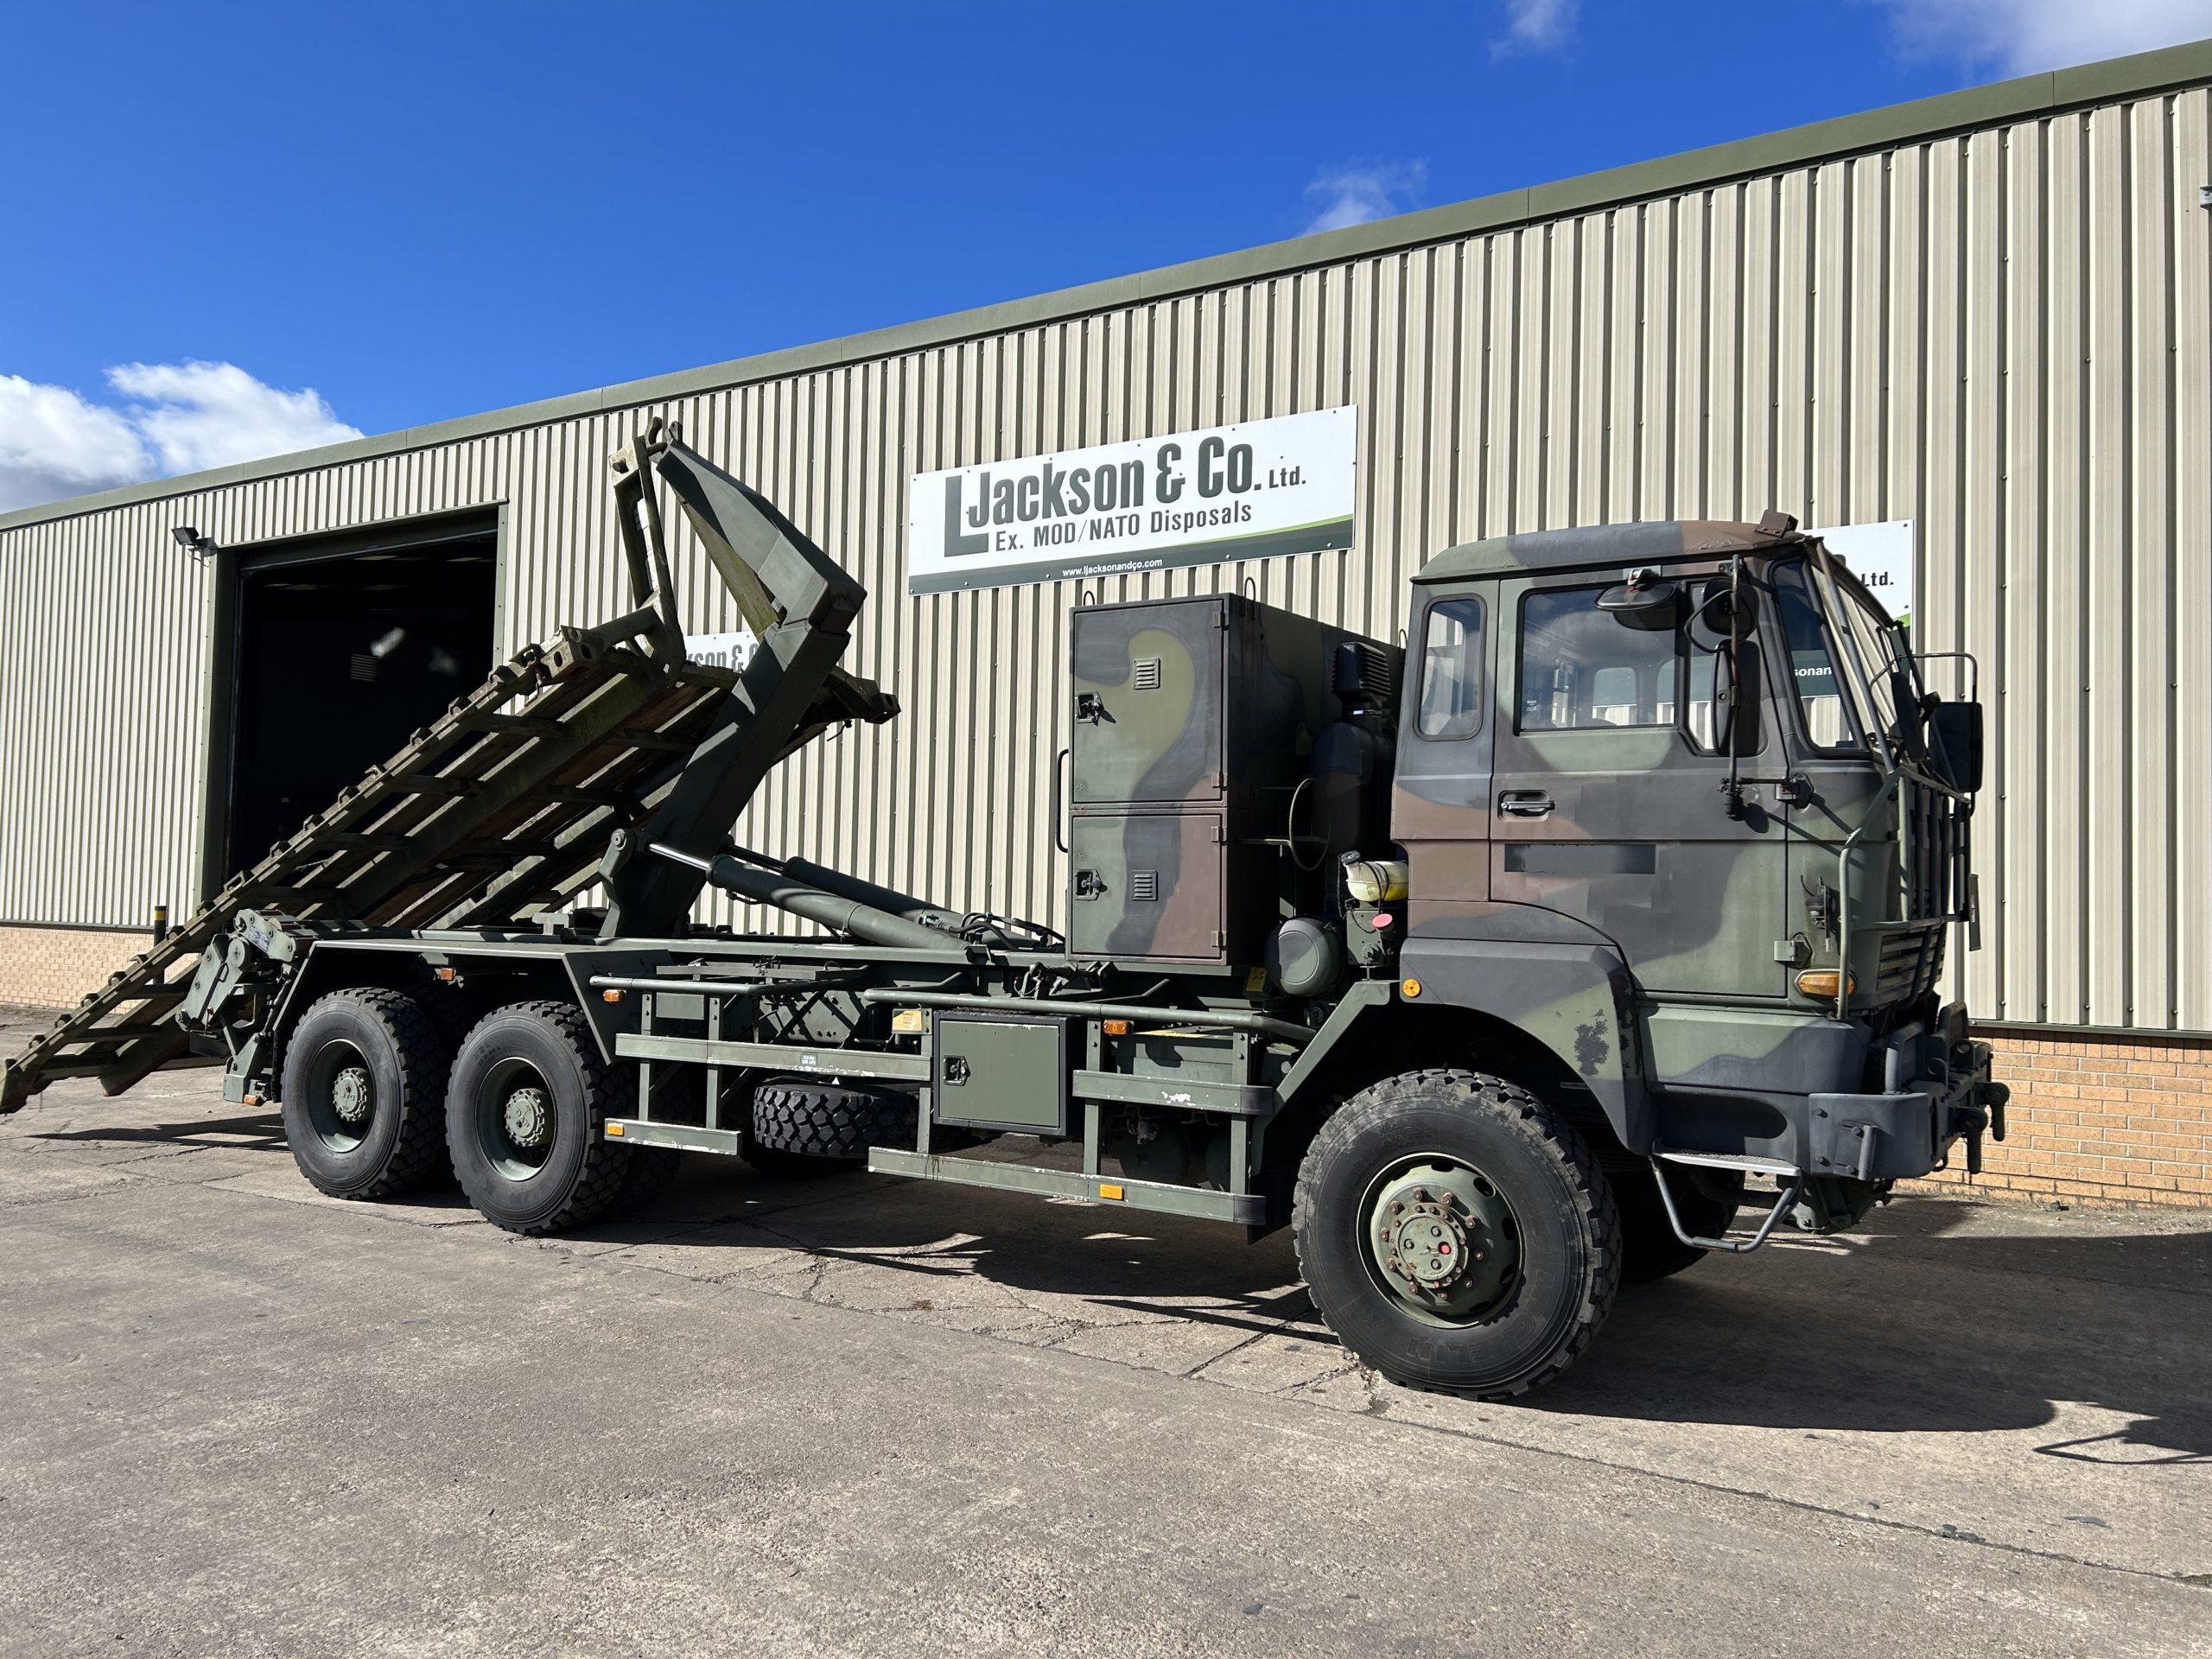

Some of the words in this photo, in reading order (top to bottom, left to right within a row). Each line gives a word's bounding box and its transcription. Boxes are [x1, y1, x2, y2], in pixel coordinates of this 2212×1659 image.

[1155, 443, 1185, 504] &
[1198, 436, 1262, 499] Co.
[1268, 466, 1306, 489] Ltd.
[995, 529, 1024, 553] Ex.
[1033, 513, 1141, 548] MOD/NATO
[1151, 500, 1252, 534] Disposals
